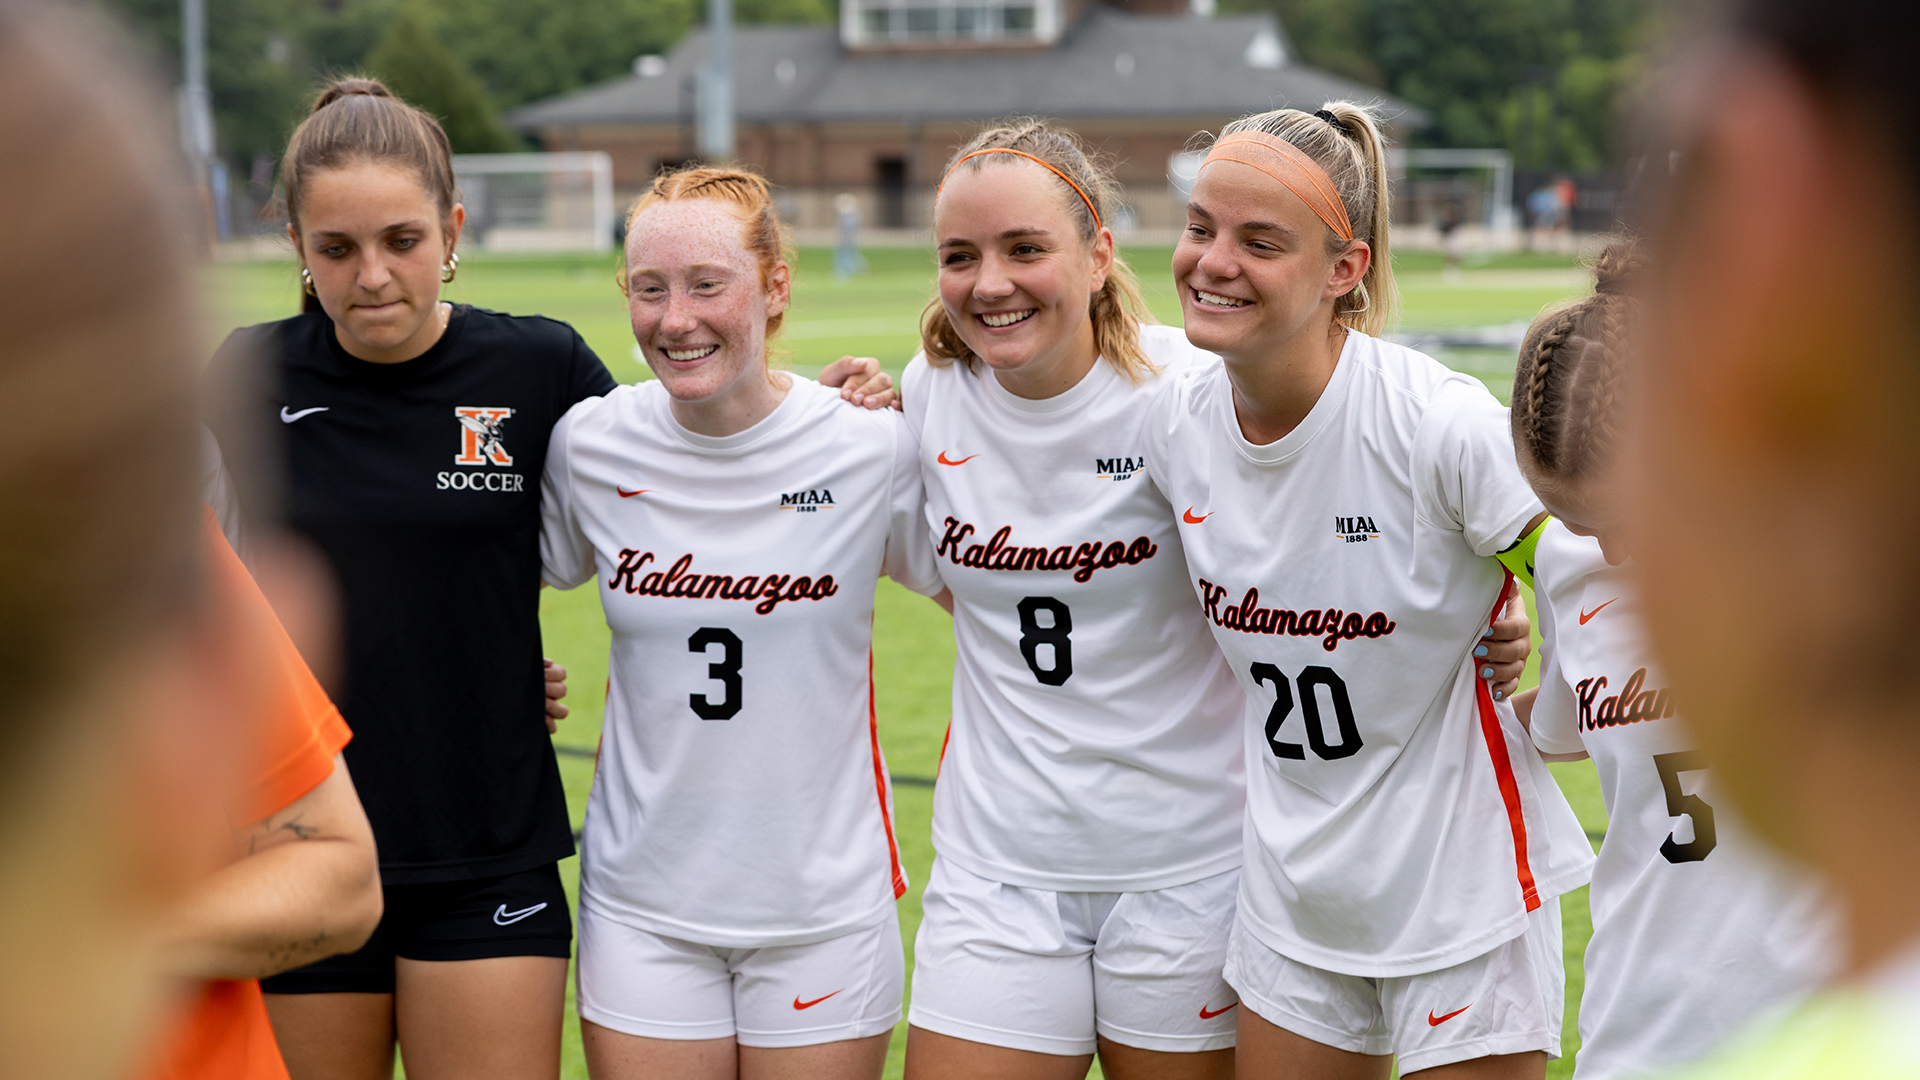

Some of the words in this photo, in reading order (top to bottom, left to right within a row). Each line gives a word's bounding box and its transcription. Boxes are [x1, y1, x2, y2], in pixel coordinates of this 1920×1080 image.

[436, 471, 524, 492] SOCCER
[780, 489, 837, 506] MIAA
[1095, 456, 1145, 474] MIAA
[796, 505, 817, 513] 1888
[1335, 516, 1380, 534] MIAA
[1345, 534, 1368, 543] 1888
[608, 547, 839, 615] Kalamazoo
[936, 516, 1158, 583] Kalamazoo
[1016, 596, 1073, 687] 8
[1198, 577, 1397, 652] Kalamazoo
[688, 627, 743, 721] 3
[1249, 661, 1365, 762] 20
[1652, 750, 1718, 864] 5
